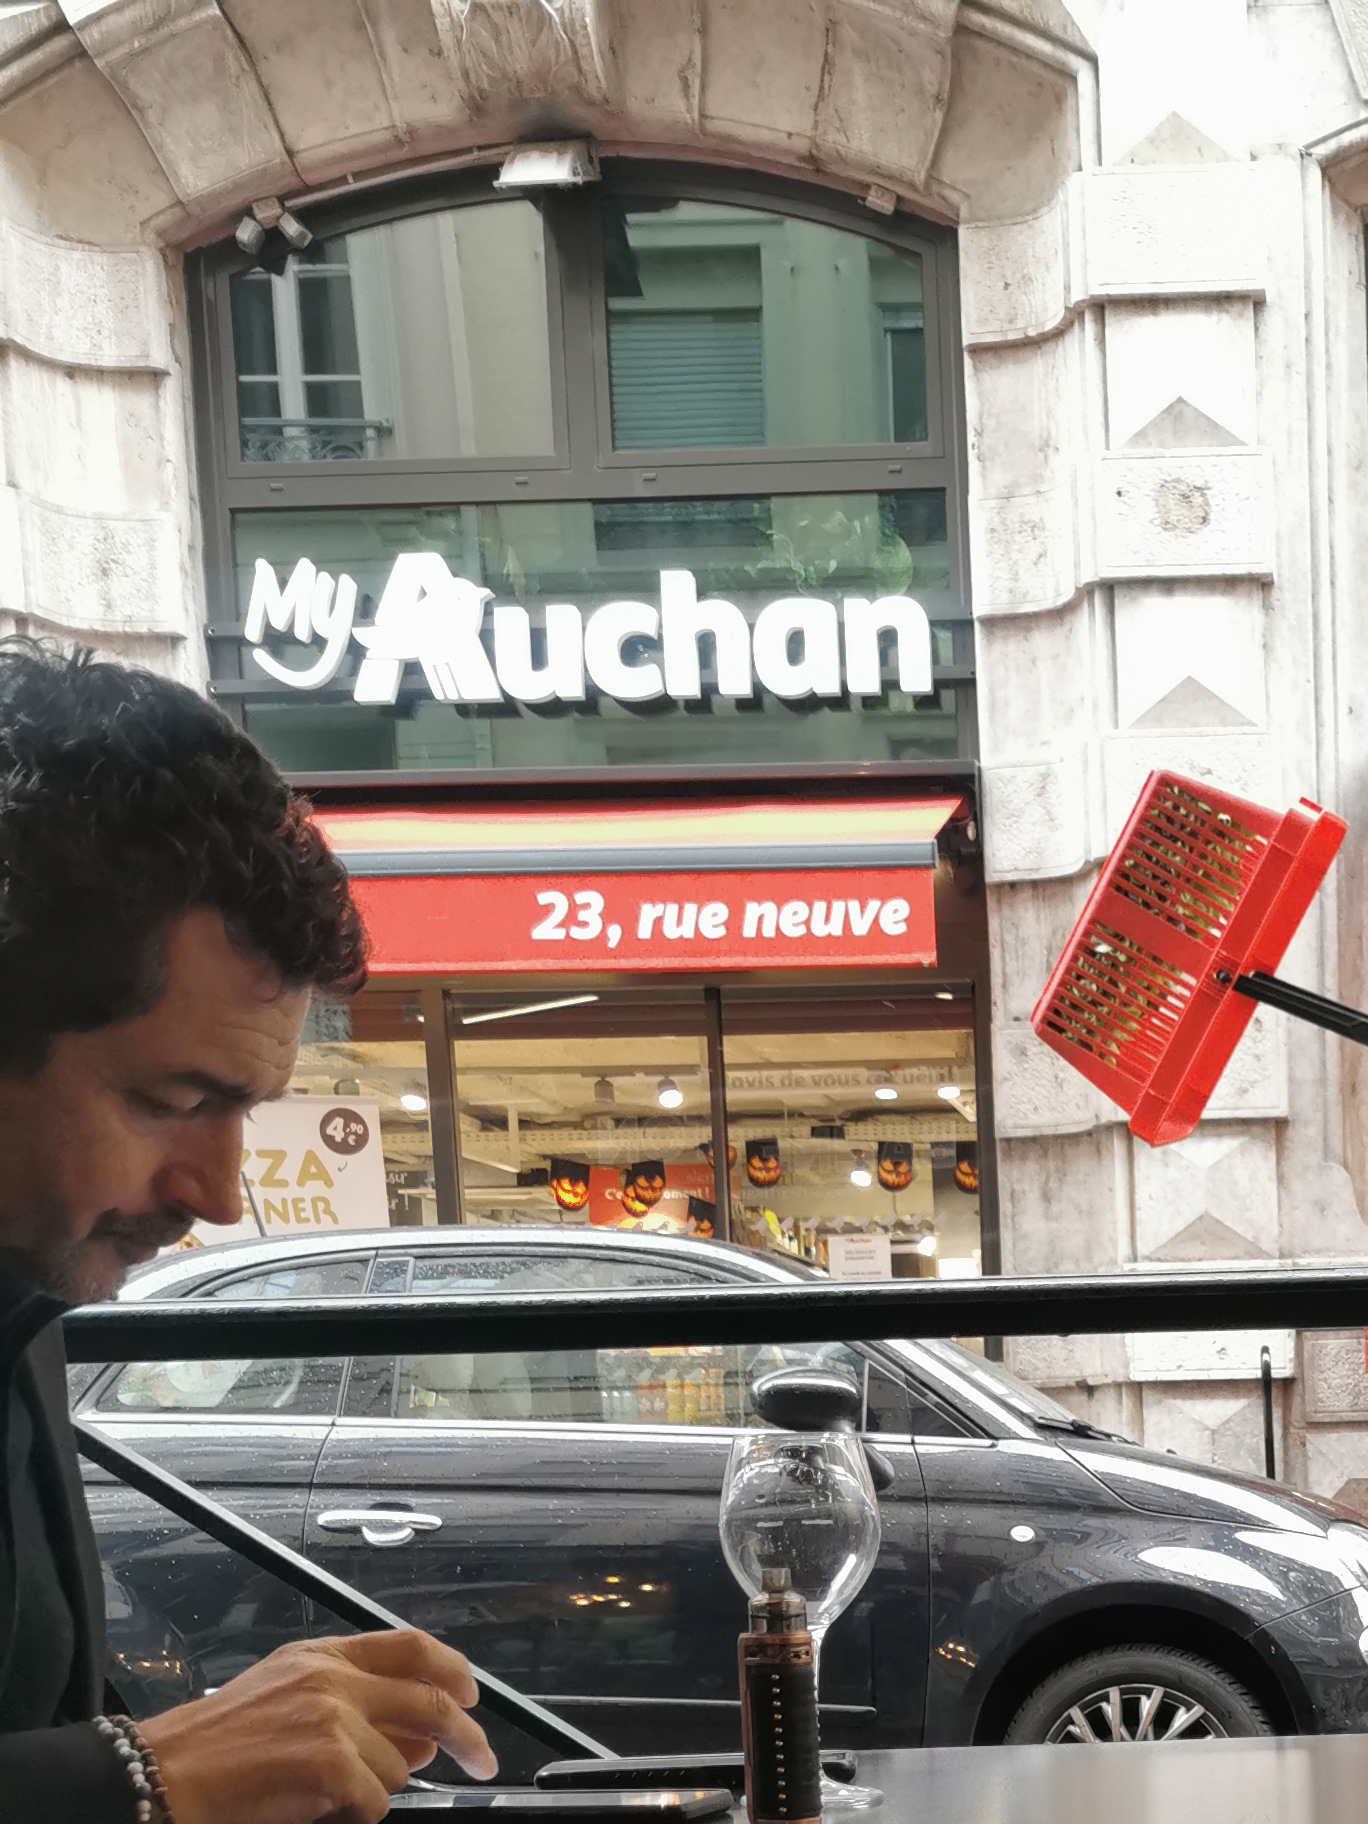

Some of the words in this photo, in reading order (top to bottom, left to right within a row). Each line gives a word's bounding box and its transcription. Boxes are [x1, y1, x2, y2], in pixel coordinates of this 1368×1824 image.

[244, 556, 357, 690] My
[352, 551, 933, 705] Auchan
[531, 890, 622, 950] 23,
[637, 900, 728, 940] rue
[742, 898, 911, 939] neuve
[727, 1069, 778, 1089] avis
[811, 1071, 863, 1088] vous
